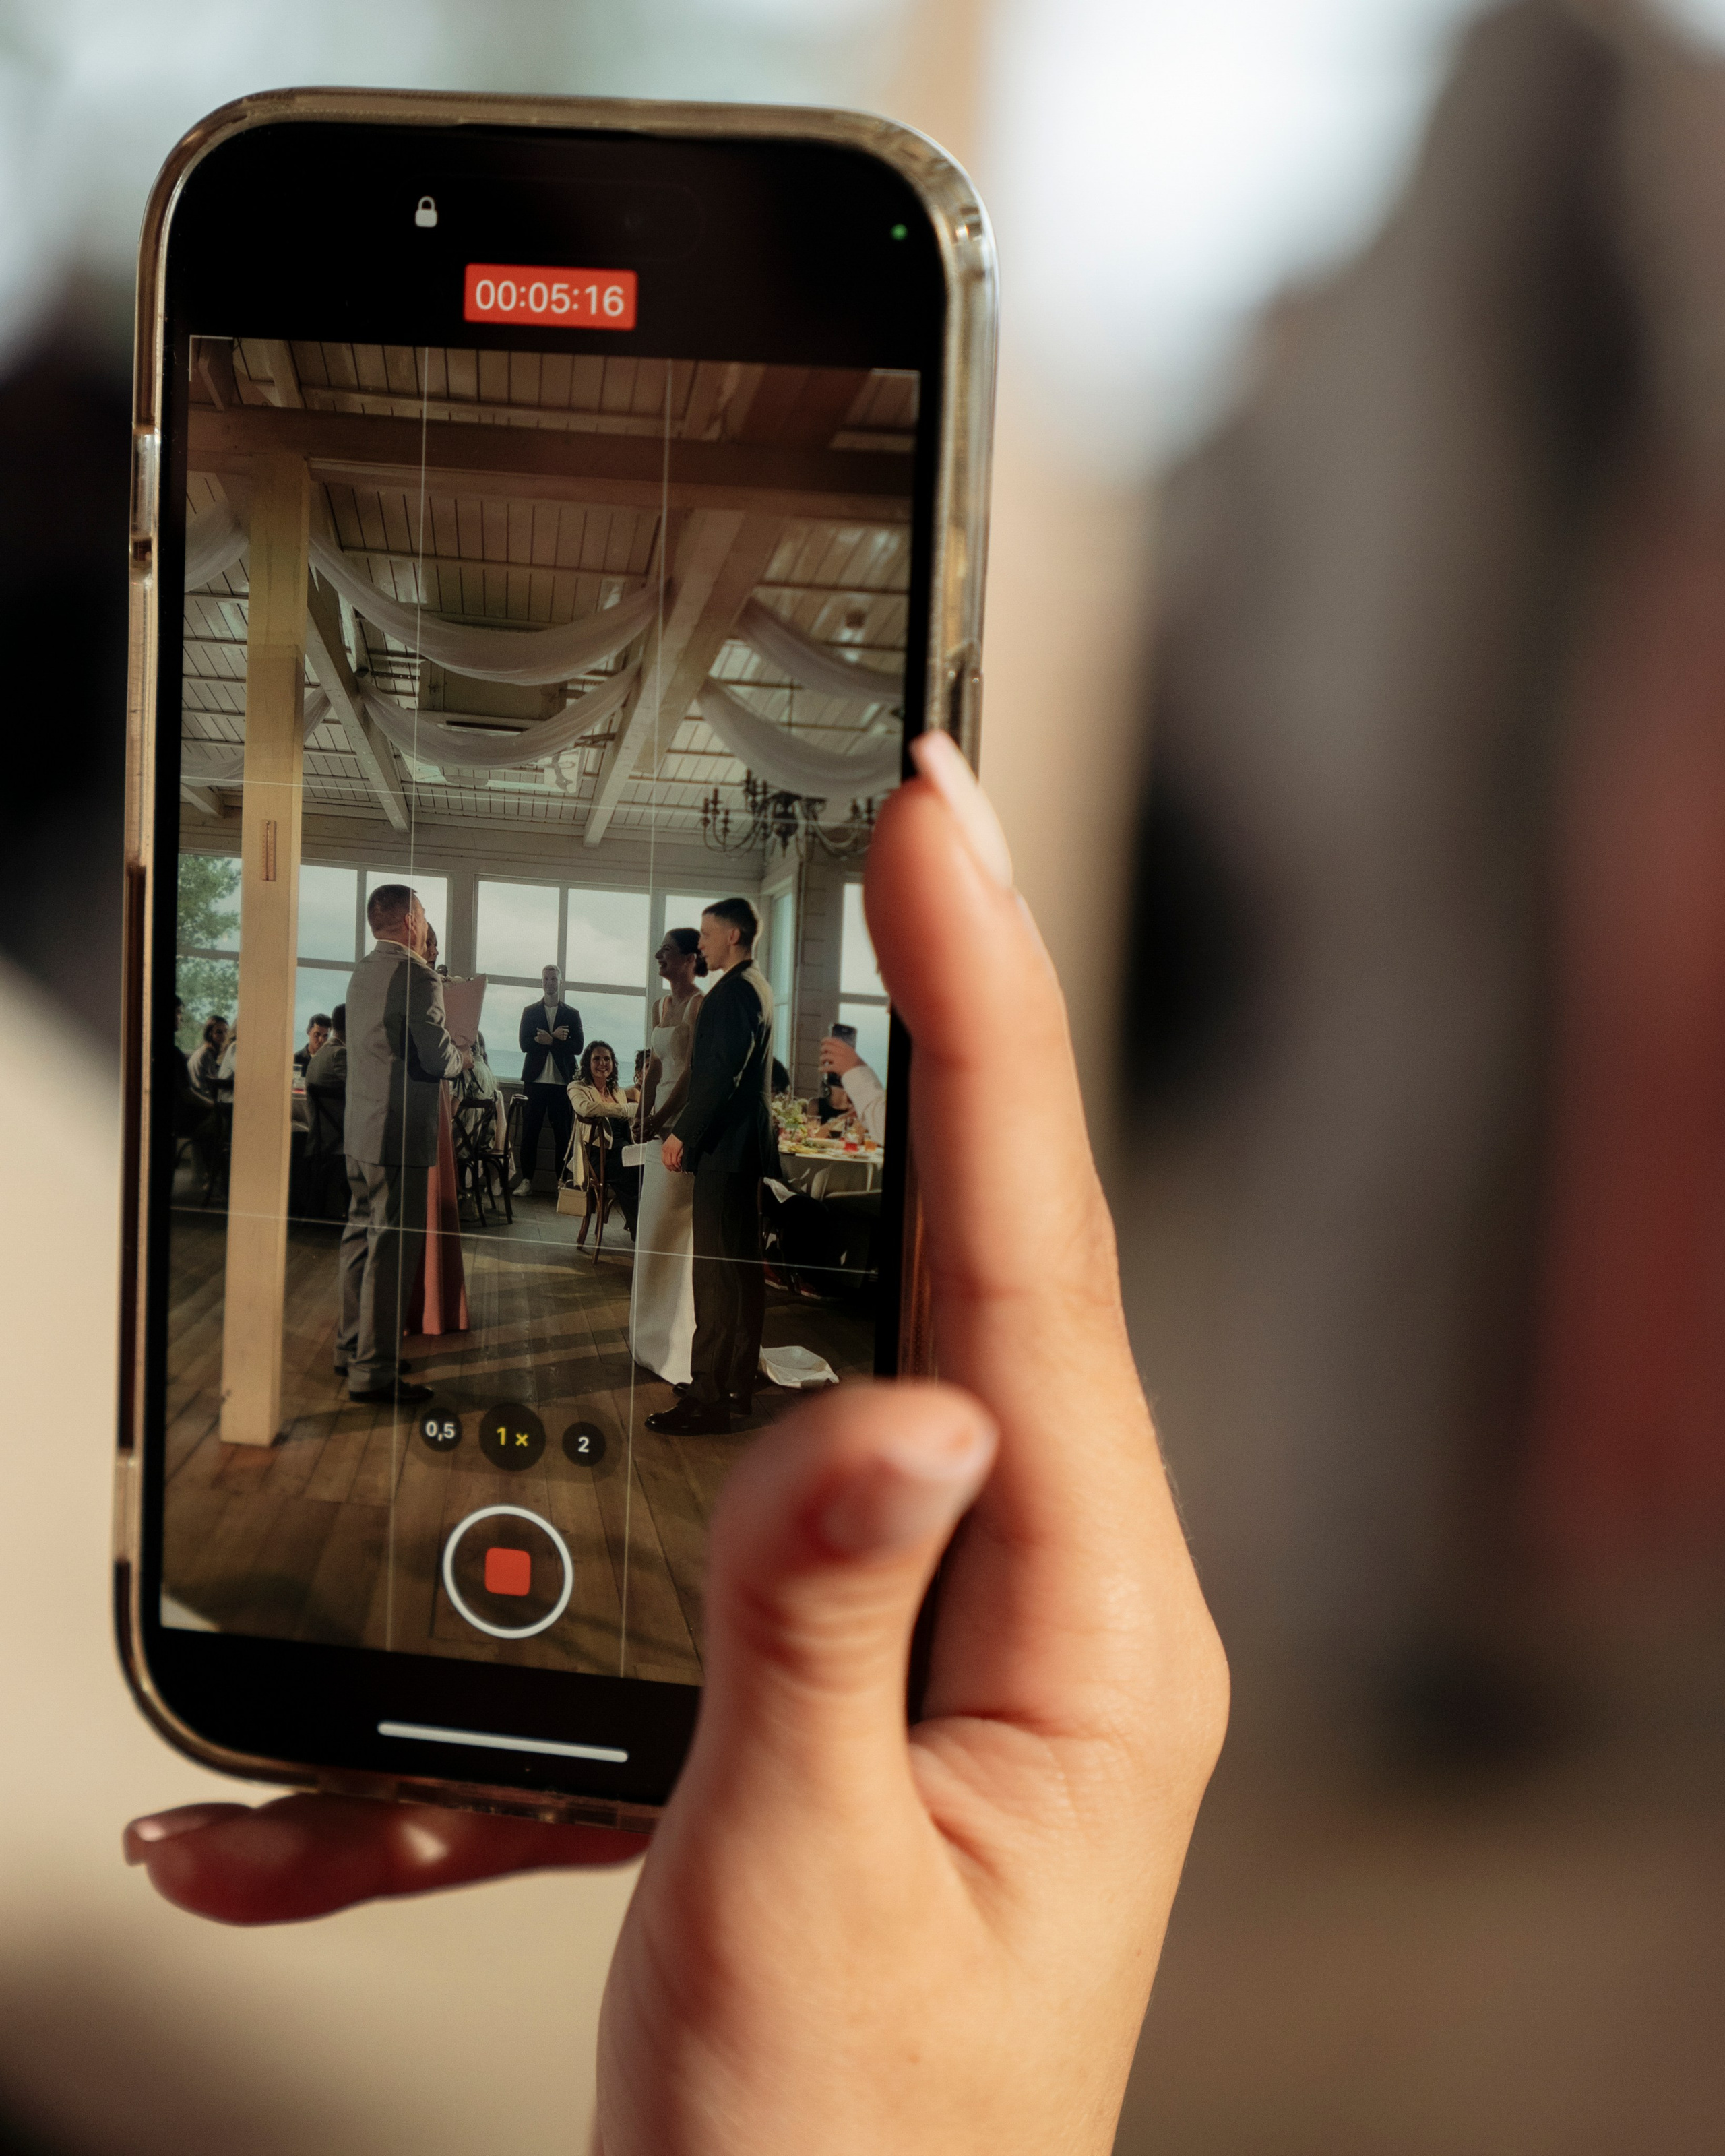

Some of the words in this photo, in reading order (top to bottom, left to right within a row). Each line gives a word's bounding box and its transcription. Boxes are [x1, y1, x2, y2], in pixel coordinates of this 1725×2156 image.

[475, 279, 624, 317] 00:05:16
[425, 1421, 456, 1441] 0,5
[577, 1436, 590, 1453] 2
